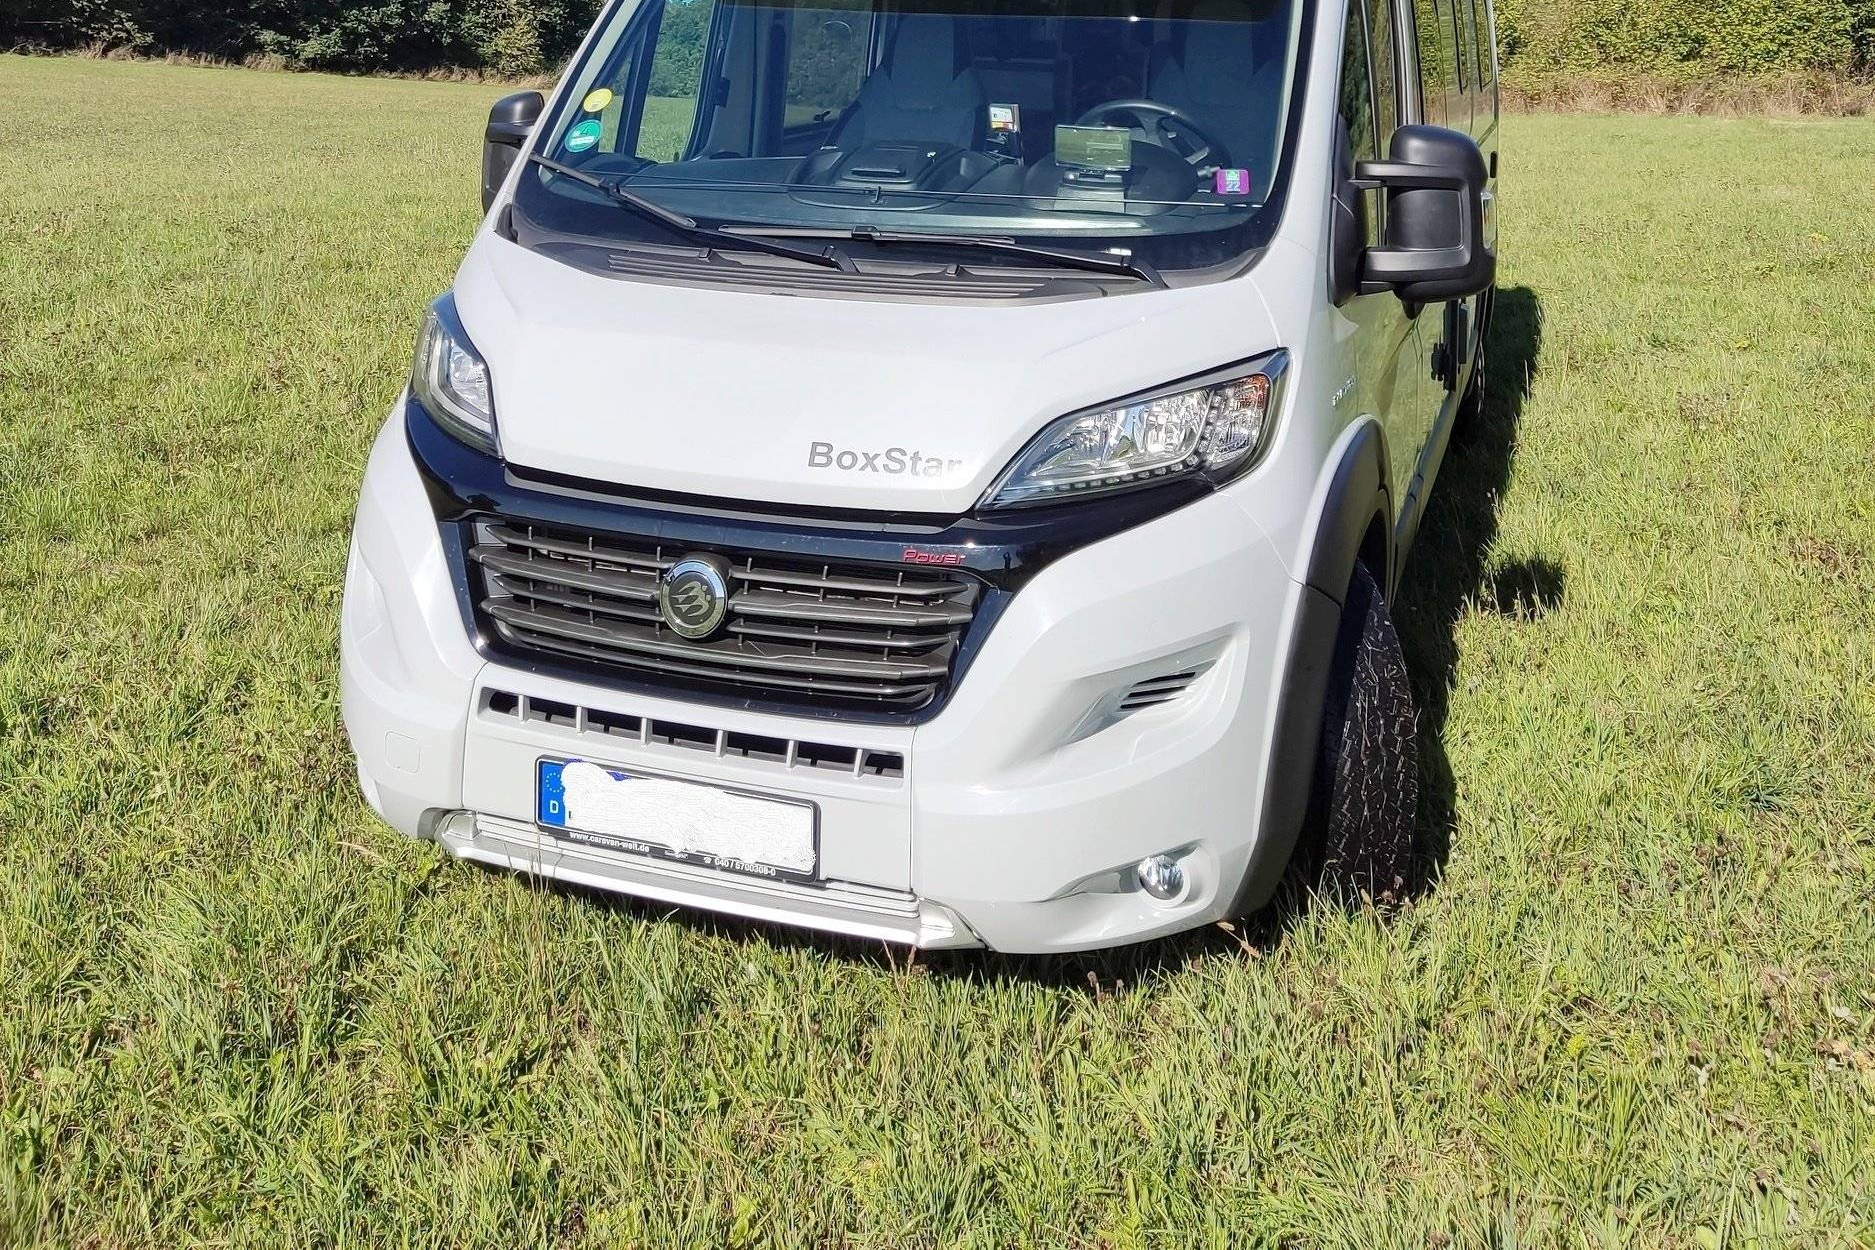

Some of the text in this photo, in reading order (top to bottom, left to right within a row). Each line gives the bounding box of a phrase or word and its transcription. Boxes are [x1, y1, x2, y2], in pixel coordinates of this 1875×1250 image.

[808, 441, 963, 477] BoxStar
[903, 549, 967, 565] Power
[549, 799, 560, 814] D
